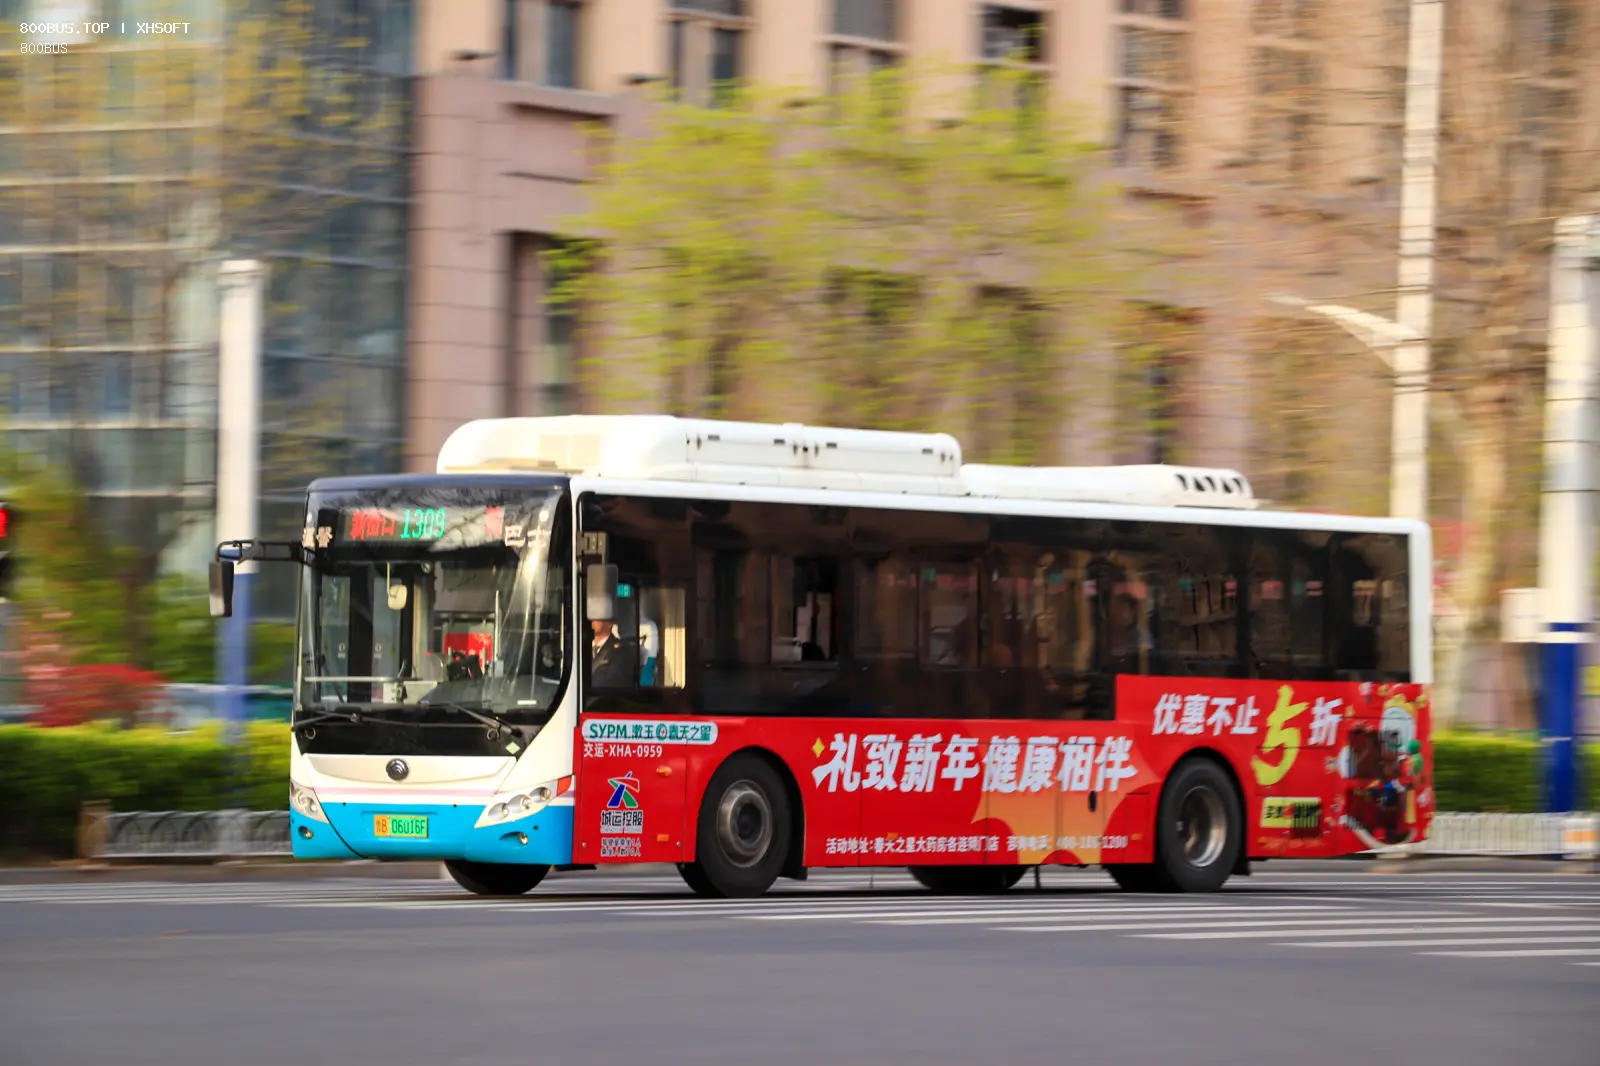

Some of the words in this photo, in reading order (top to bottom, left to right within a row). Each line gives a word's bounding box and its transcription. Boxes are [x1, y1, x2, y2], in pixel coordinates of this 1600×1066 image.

[400, 508, 446, 539] 1309
[583, 743, 663, 758] 交运-XHA-0959
[811, 732, 1138, 793] 礼致新年健康相伴
[601, 810, 643, 827] 城运控股
